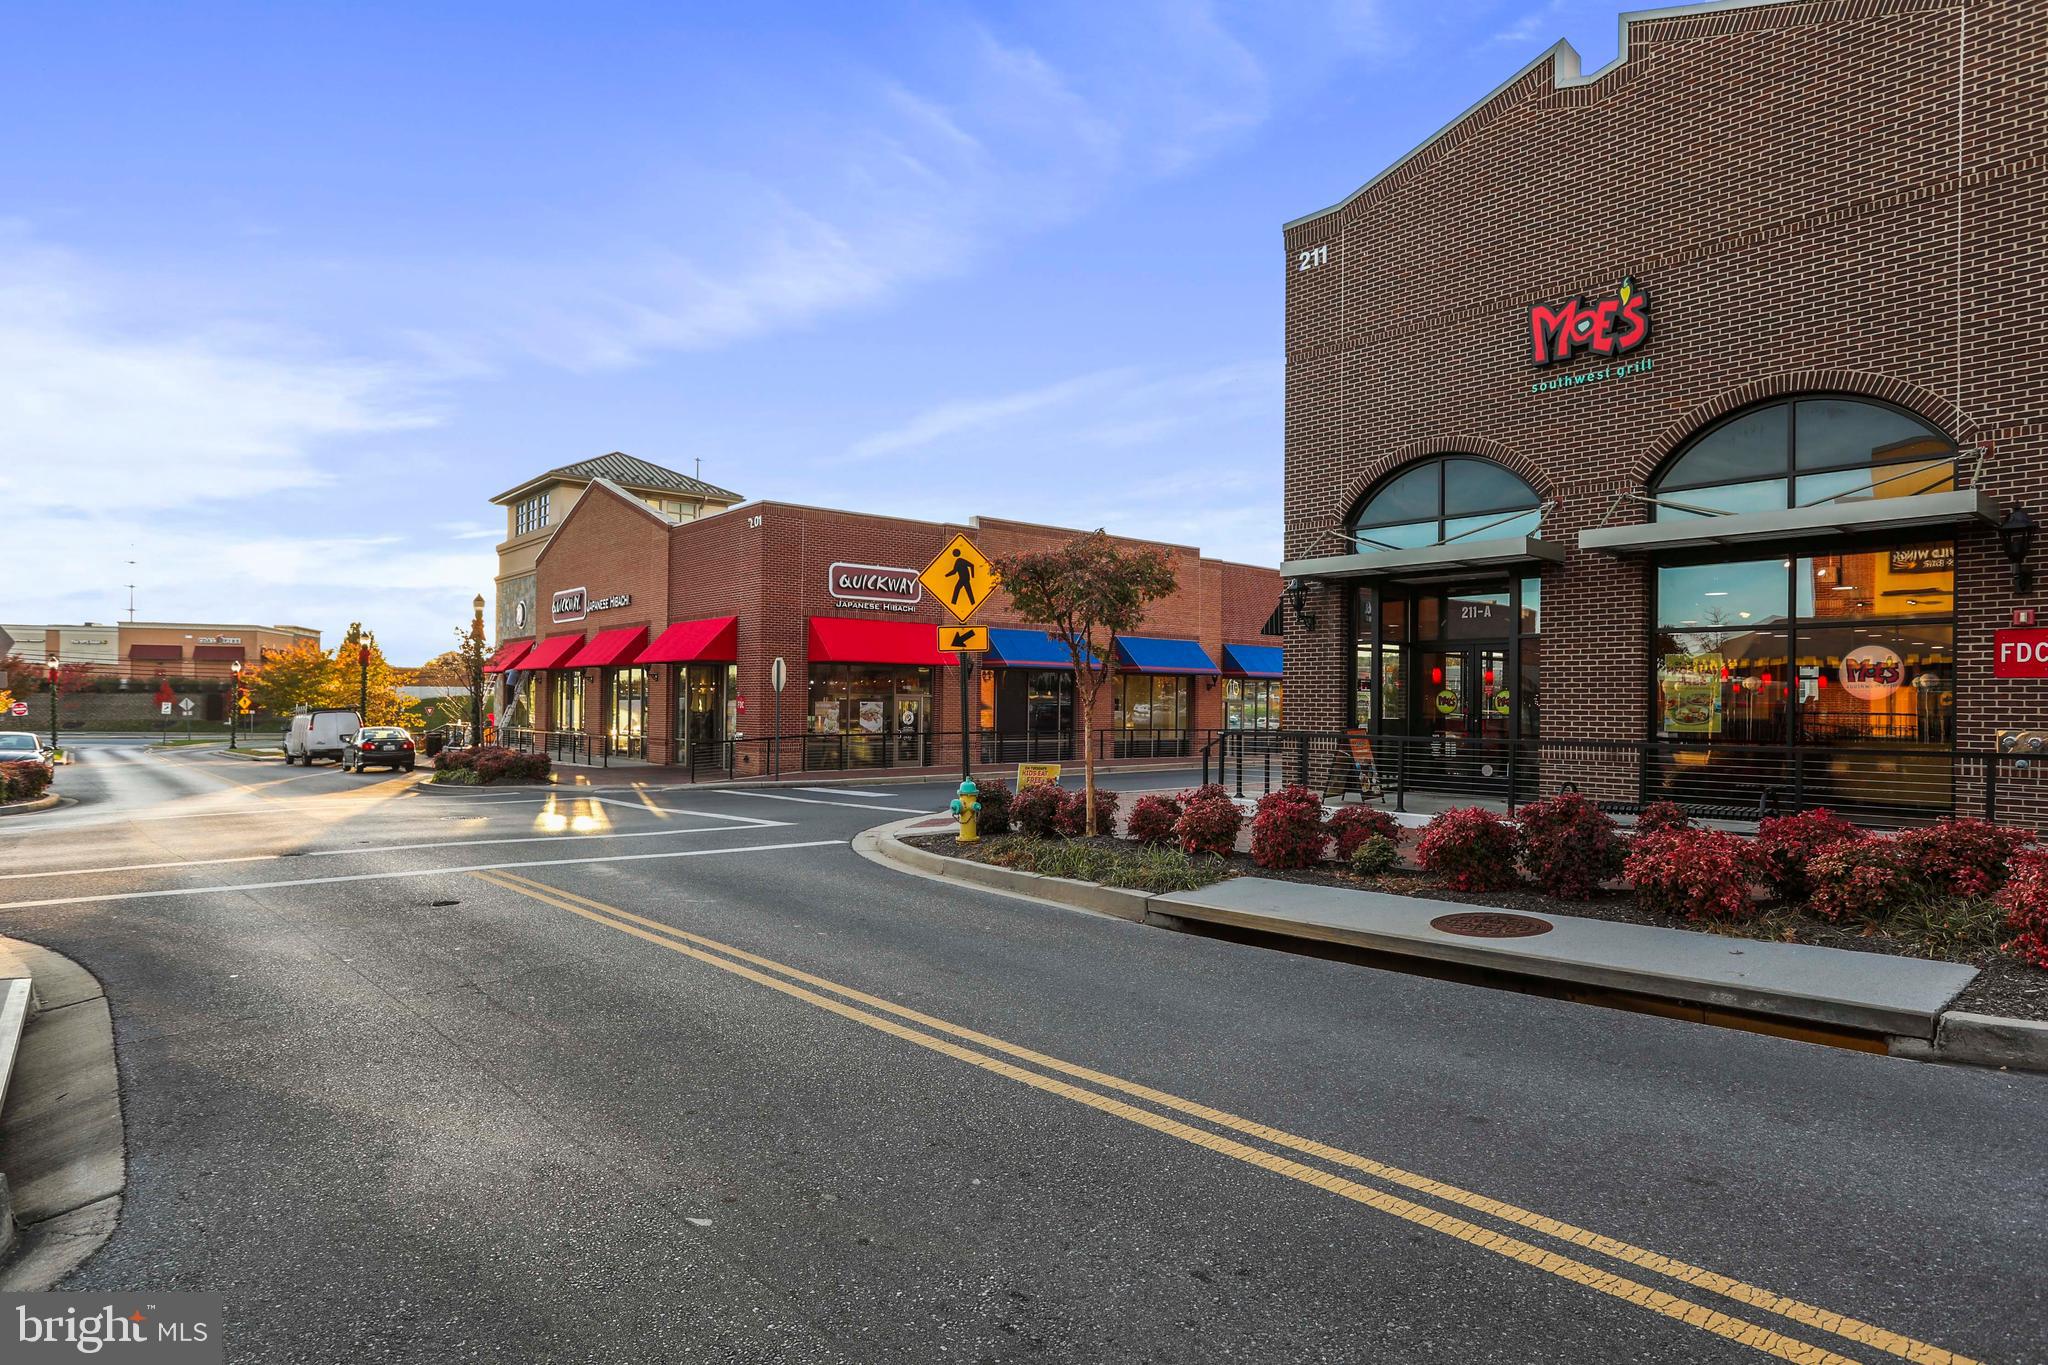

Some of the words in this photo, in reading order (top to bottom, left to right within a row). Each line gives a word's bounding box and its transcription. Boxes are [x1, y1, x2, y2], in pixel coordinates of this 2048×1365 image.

[1298, 245, 1328, 271] 211
[1531, 366, 1611, 393] southwest
[1617, 358, 1653, 378] grill
[747, 514, 762, 529] 201
[838, 574, 918, 594] QUICKWAY
[1461, 605, 1492, 619] 211-A
[2001, 642, 2048, 663] FDC
